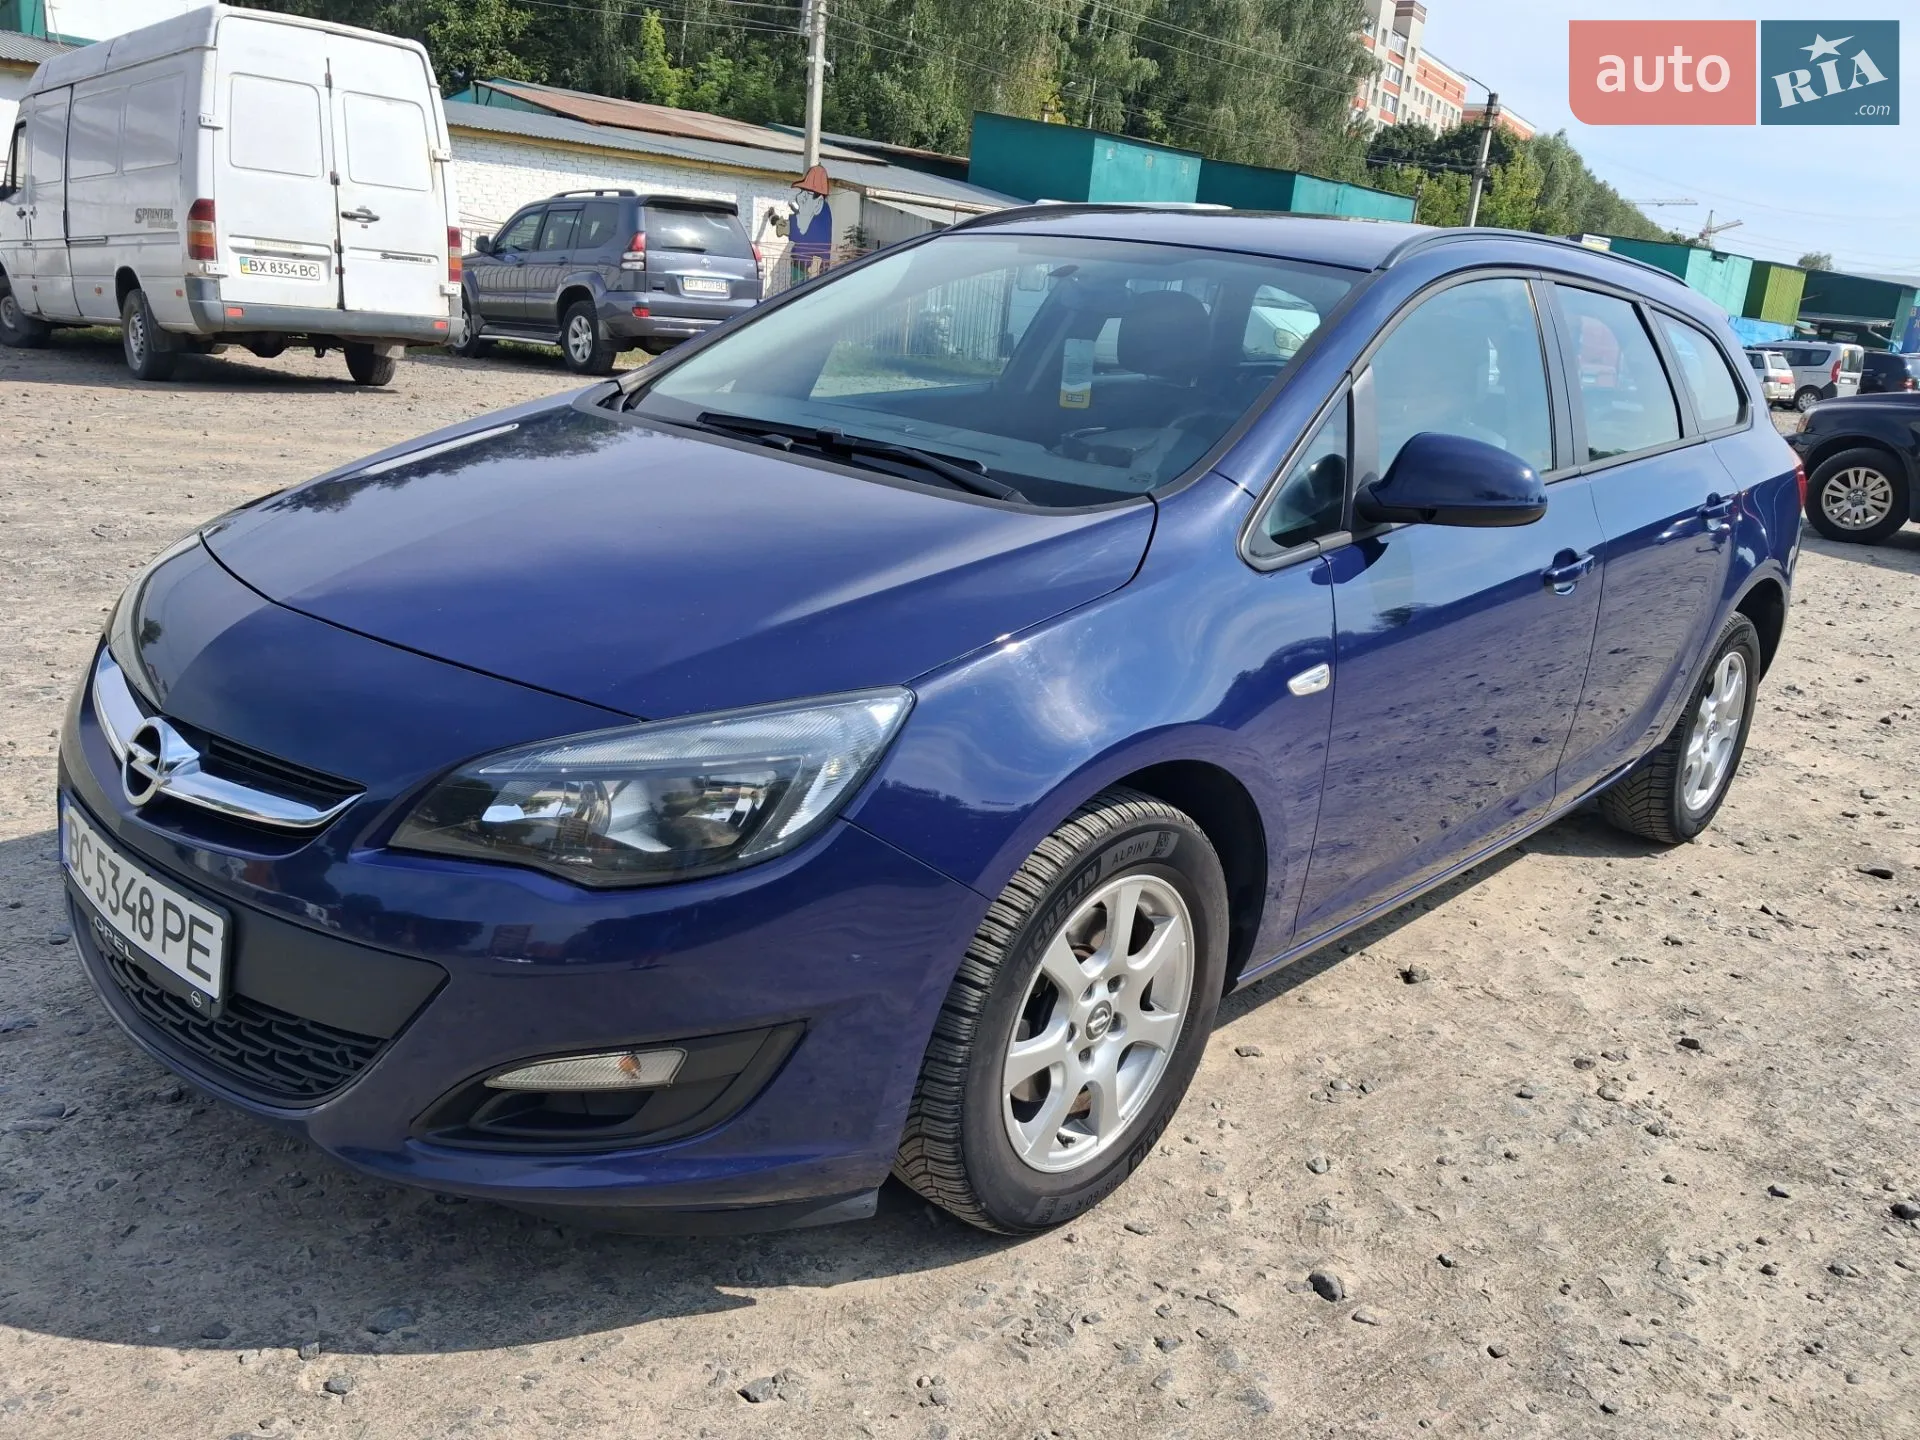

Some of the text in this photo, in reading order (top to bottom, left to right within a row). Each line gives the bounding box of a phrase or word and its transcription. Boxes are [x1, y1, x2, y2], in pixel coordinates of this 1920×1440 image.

[134, 207, 174, 224] SPRINTER
[249, 259, 317, 278] BX 8354 BC
[68, 815, 214, 983] BC 5348 PE
[93, 915, 136, 962] OPEL
